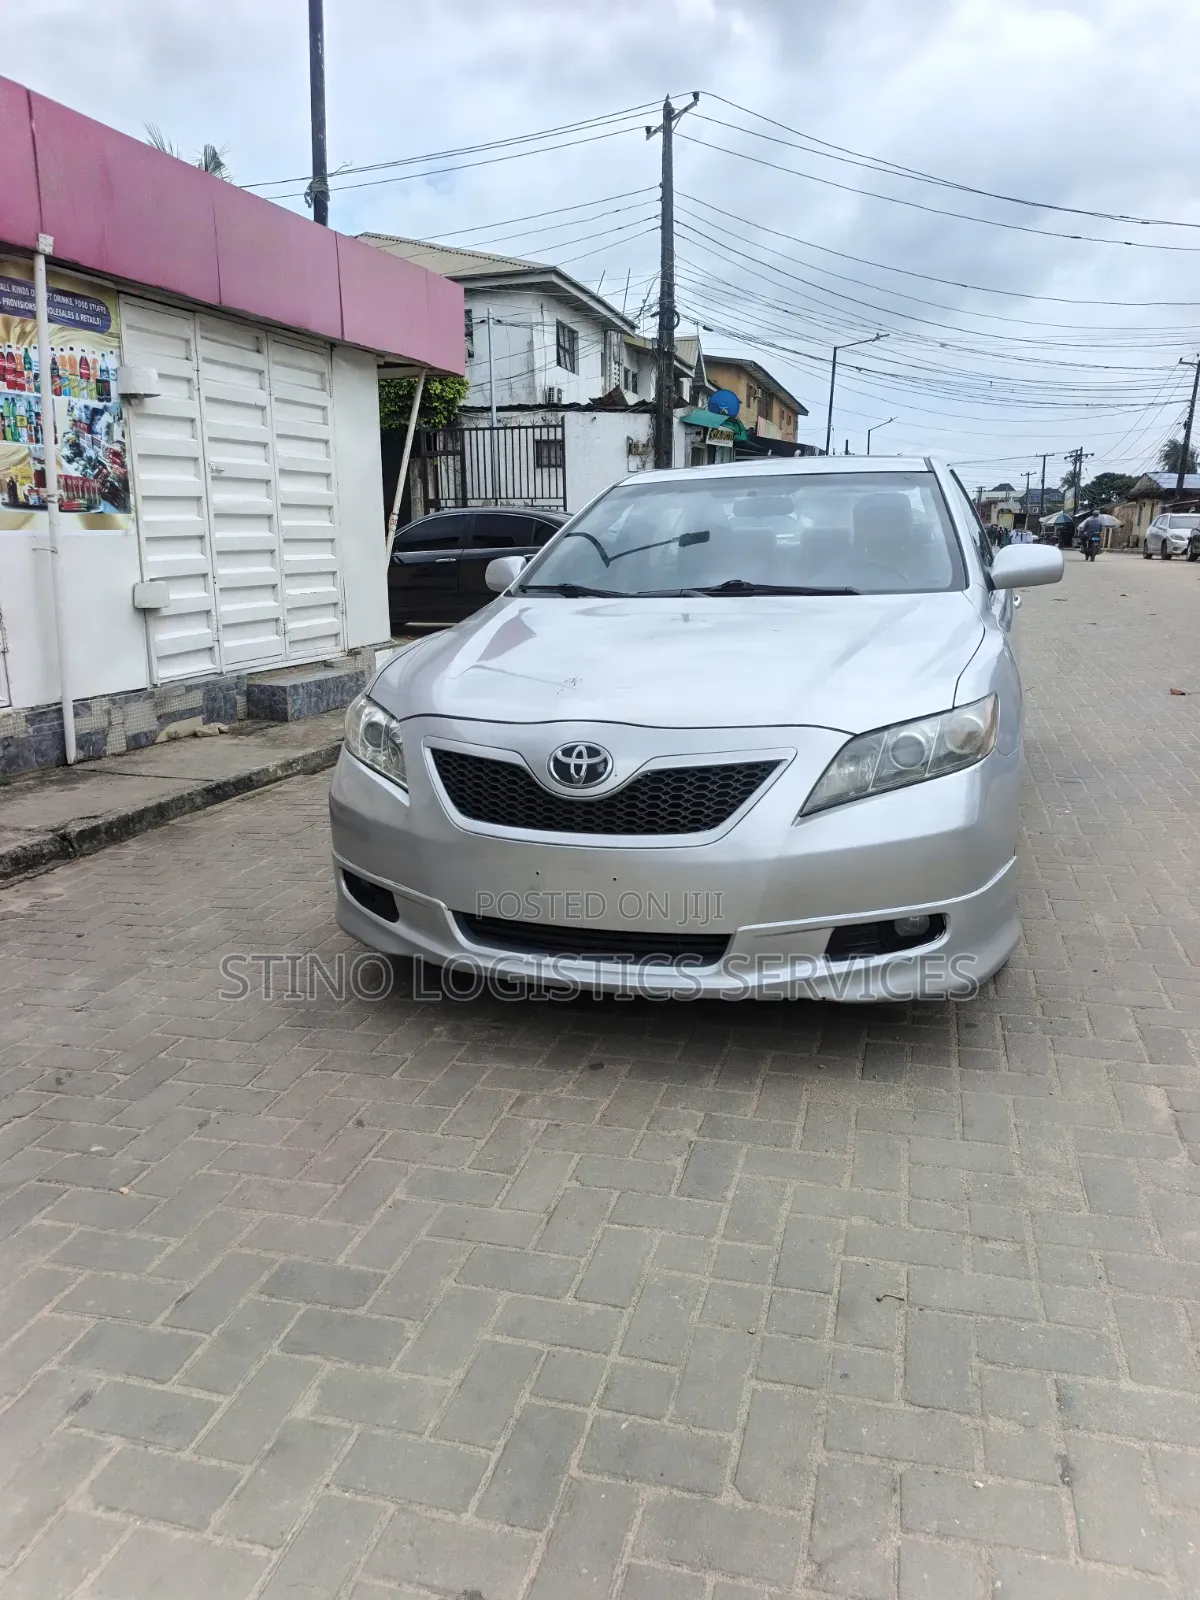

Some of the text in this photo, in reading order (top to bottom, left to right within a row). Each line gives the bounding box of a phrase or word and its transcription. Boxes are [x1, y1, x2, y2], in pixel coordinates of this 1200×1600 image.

[0, 282, 11, 292] ALL
[12, 284, 30, 296] KINDS
[75, 299, 89, 310] FOOD
[89, 302, 107, 315] STUFFS
[2, 297, 37, 311] PROVISIONS
